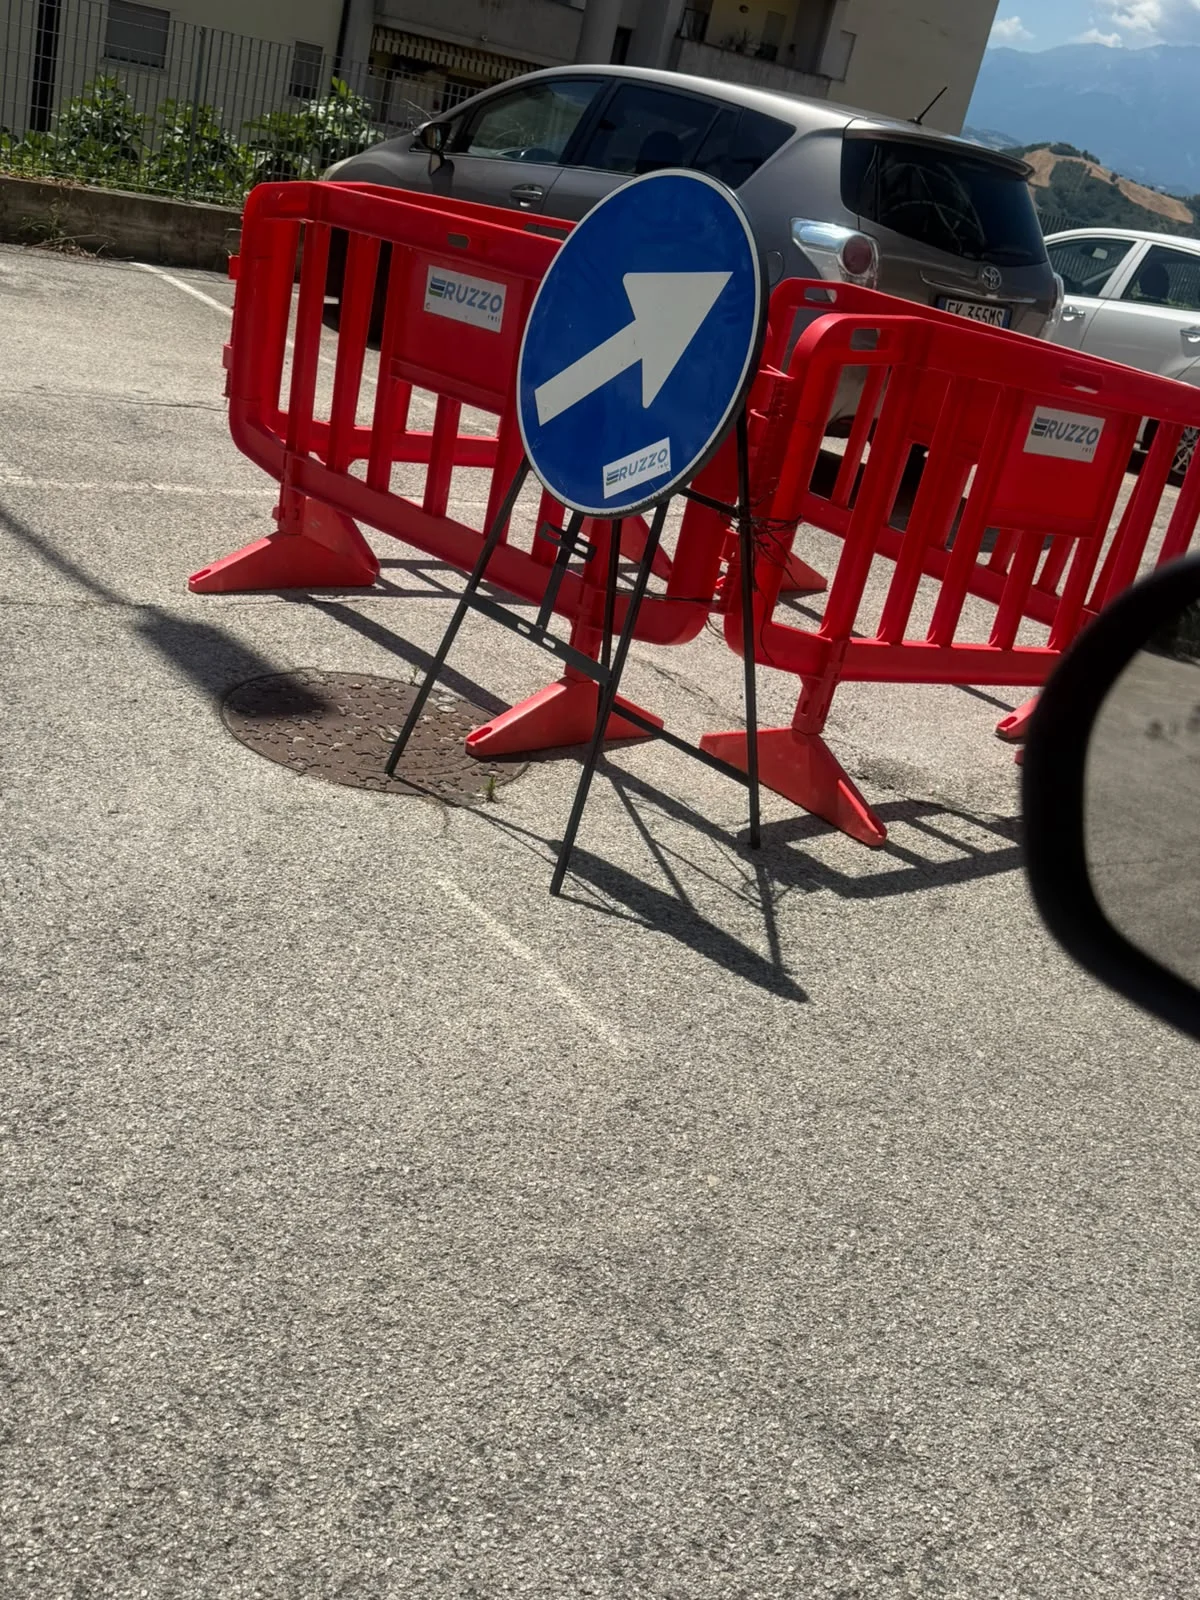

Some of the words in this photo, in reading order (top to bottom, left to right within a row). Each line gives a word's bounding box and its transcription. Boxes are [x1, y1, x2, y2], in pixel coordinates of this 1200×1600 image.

[443, 281, 503, 313] RUZZO
[1043, 419, 1100, 446] RUZZO
[618, 447, 668, 481] RUZZO
